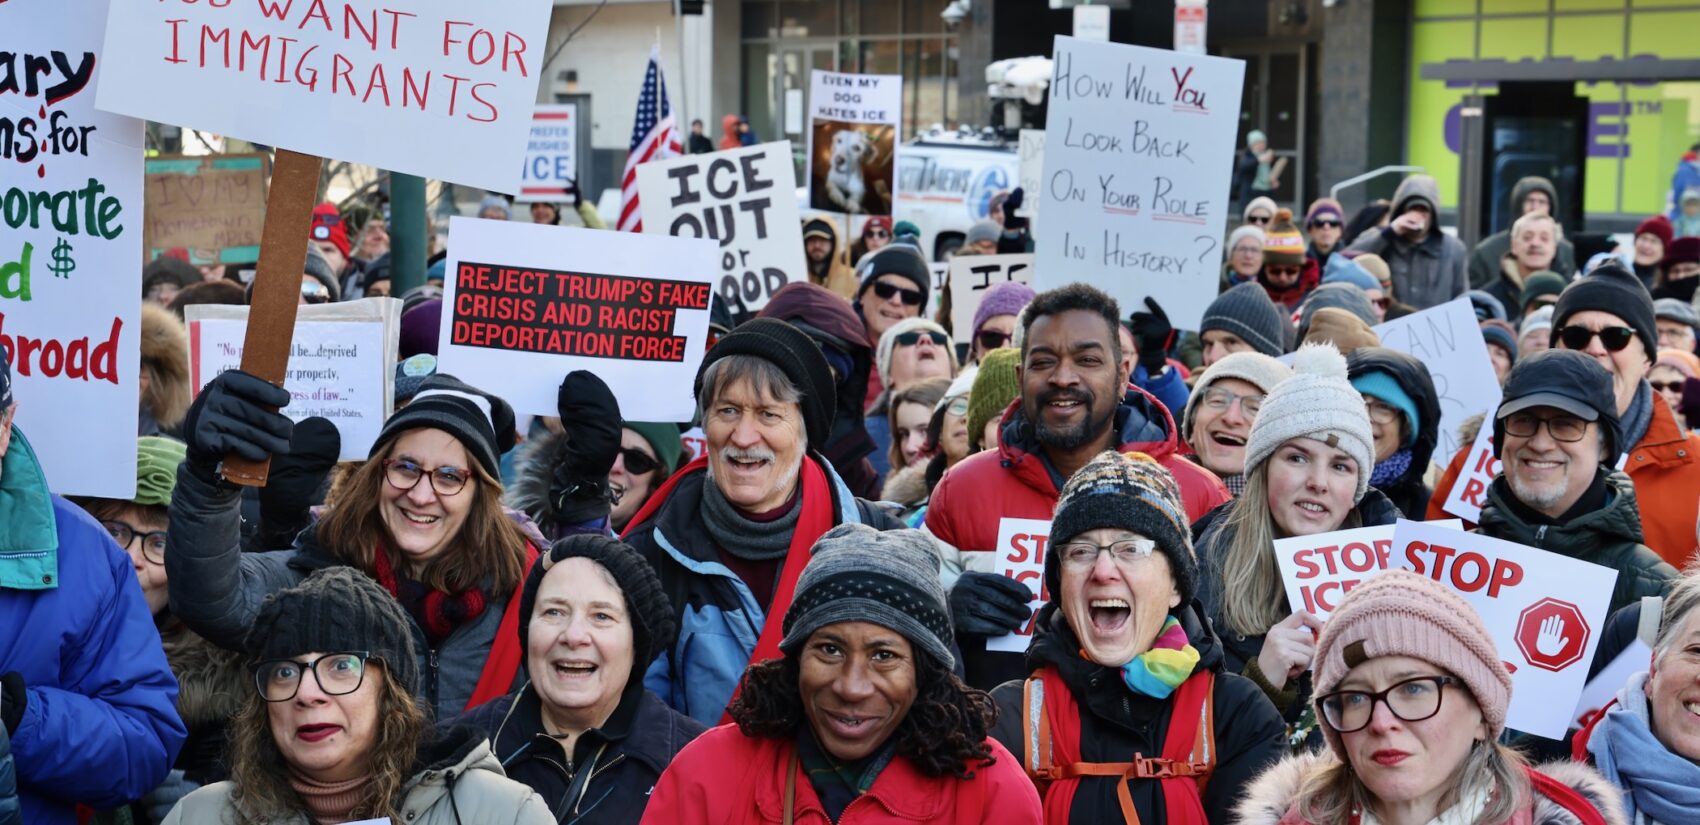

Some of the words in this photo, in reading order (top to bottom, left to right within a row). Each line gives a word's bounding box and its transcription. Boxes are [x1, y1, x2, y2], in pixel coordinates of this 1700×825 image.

[257, 0, 417, 50] WANT
[443, 21, 528, 77] FOR
[164, 19, 498, 122] IMMIGRANTS
[823, 75, 852, 86] EVEN
[858, 78, 880, 87] MY
[819, 107, 857, 119] HATES
[863, 110, 886, 120] ICE
[834, 92, 862, 103] DOG
[48, 110, 96, 156] for
[154, 175, 175, 206] I
[668, 152, 774, 208] ICE
[0, 178, 123, 240] orate
[670, 197, 771, 247] OUT
[722, 249, 750, 271] or
[458, 265, 549, 295] REJECT
[555, 273, 653, 305] TRUMP'S
[658, 282, 710, 309] FAKE
[456, 293, 537, 323] CRISIS
[541, 301, 593, 328] AND
[598, 306, 673, 333] RACIST
[454, 321, 615, 356] DEPORTATION
[620, 335, 685, 361] FORCE
[320, 408, 340, 417] United
[1293, 539, 1393, 580] STOP
[1401, 540, 1524, 598] STOP
